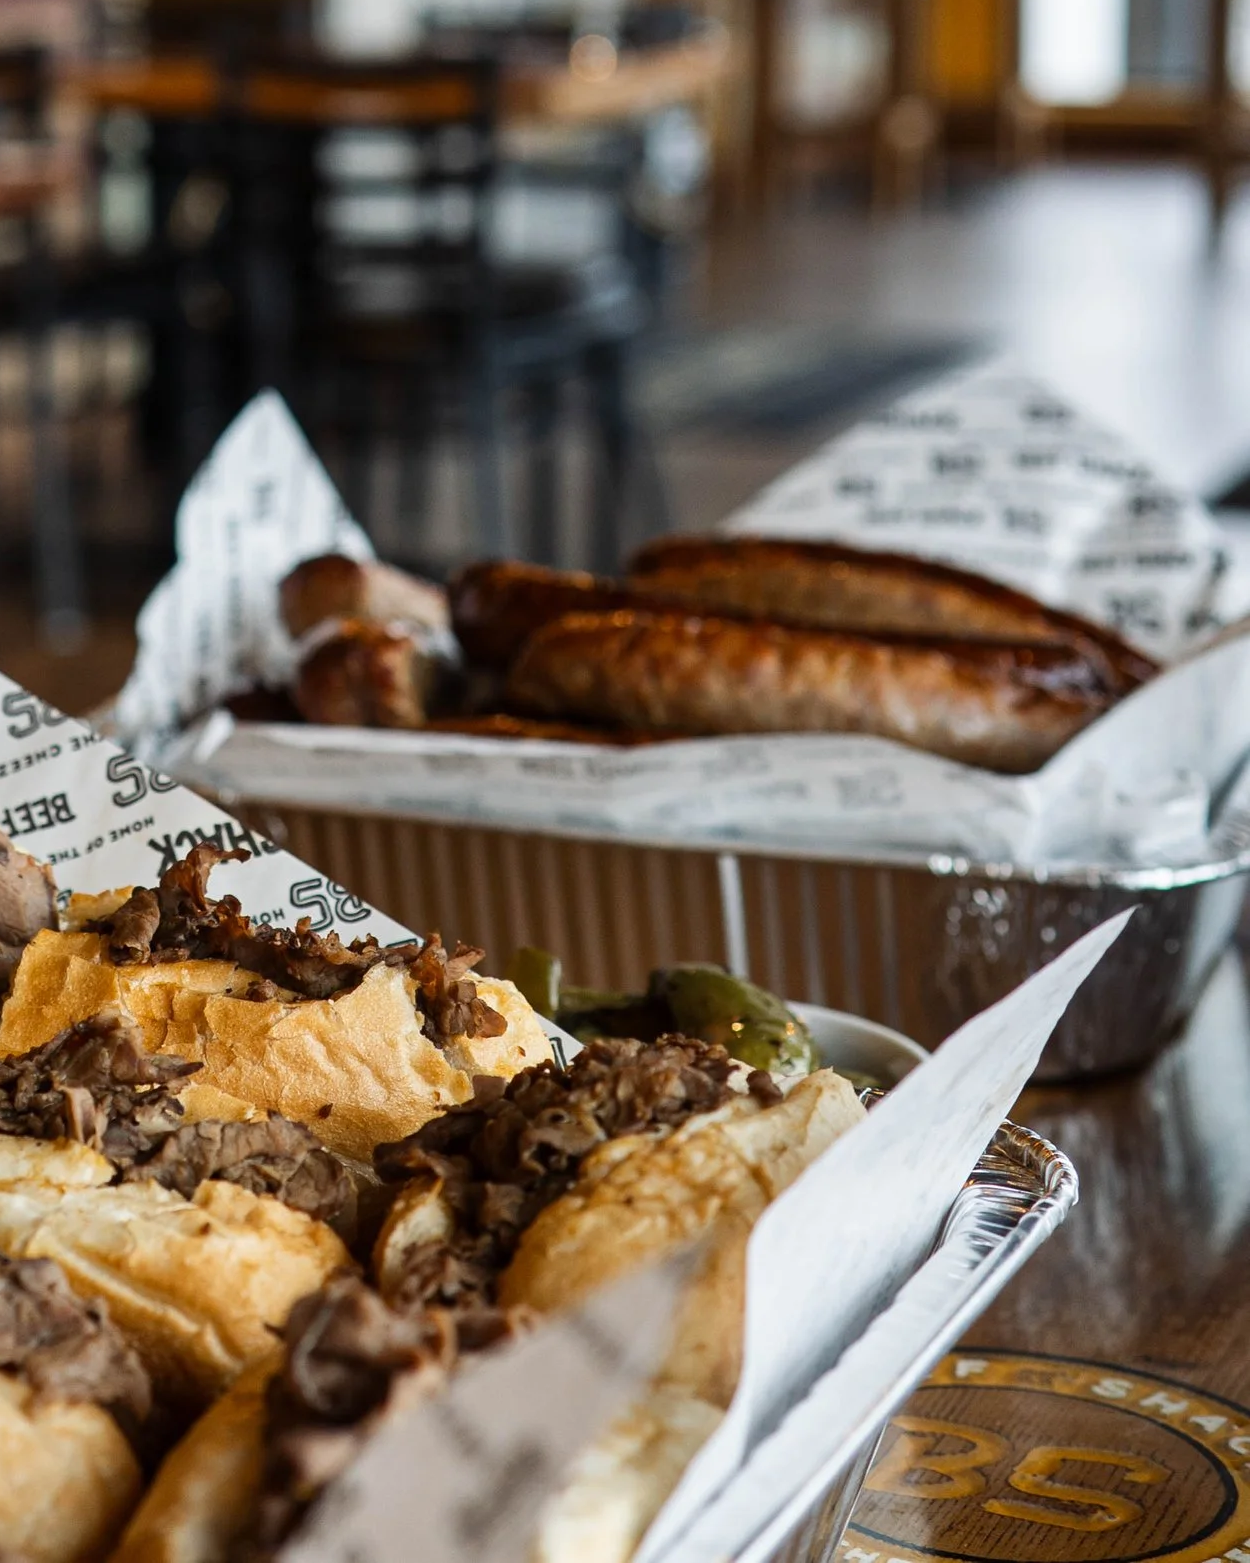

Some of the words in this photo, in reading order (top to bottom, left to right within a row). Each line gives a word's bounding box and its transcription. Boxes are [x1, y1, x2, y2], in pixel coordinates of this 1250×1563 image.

[1, 791, 77, 839] BEEF
[109, 815, 156, 844] HOME
[47, 846, 82, 867] THE
[85, 836, 105, 853] OF
[147, 822, 280, 878] HACK
